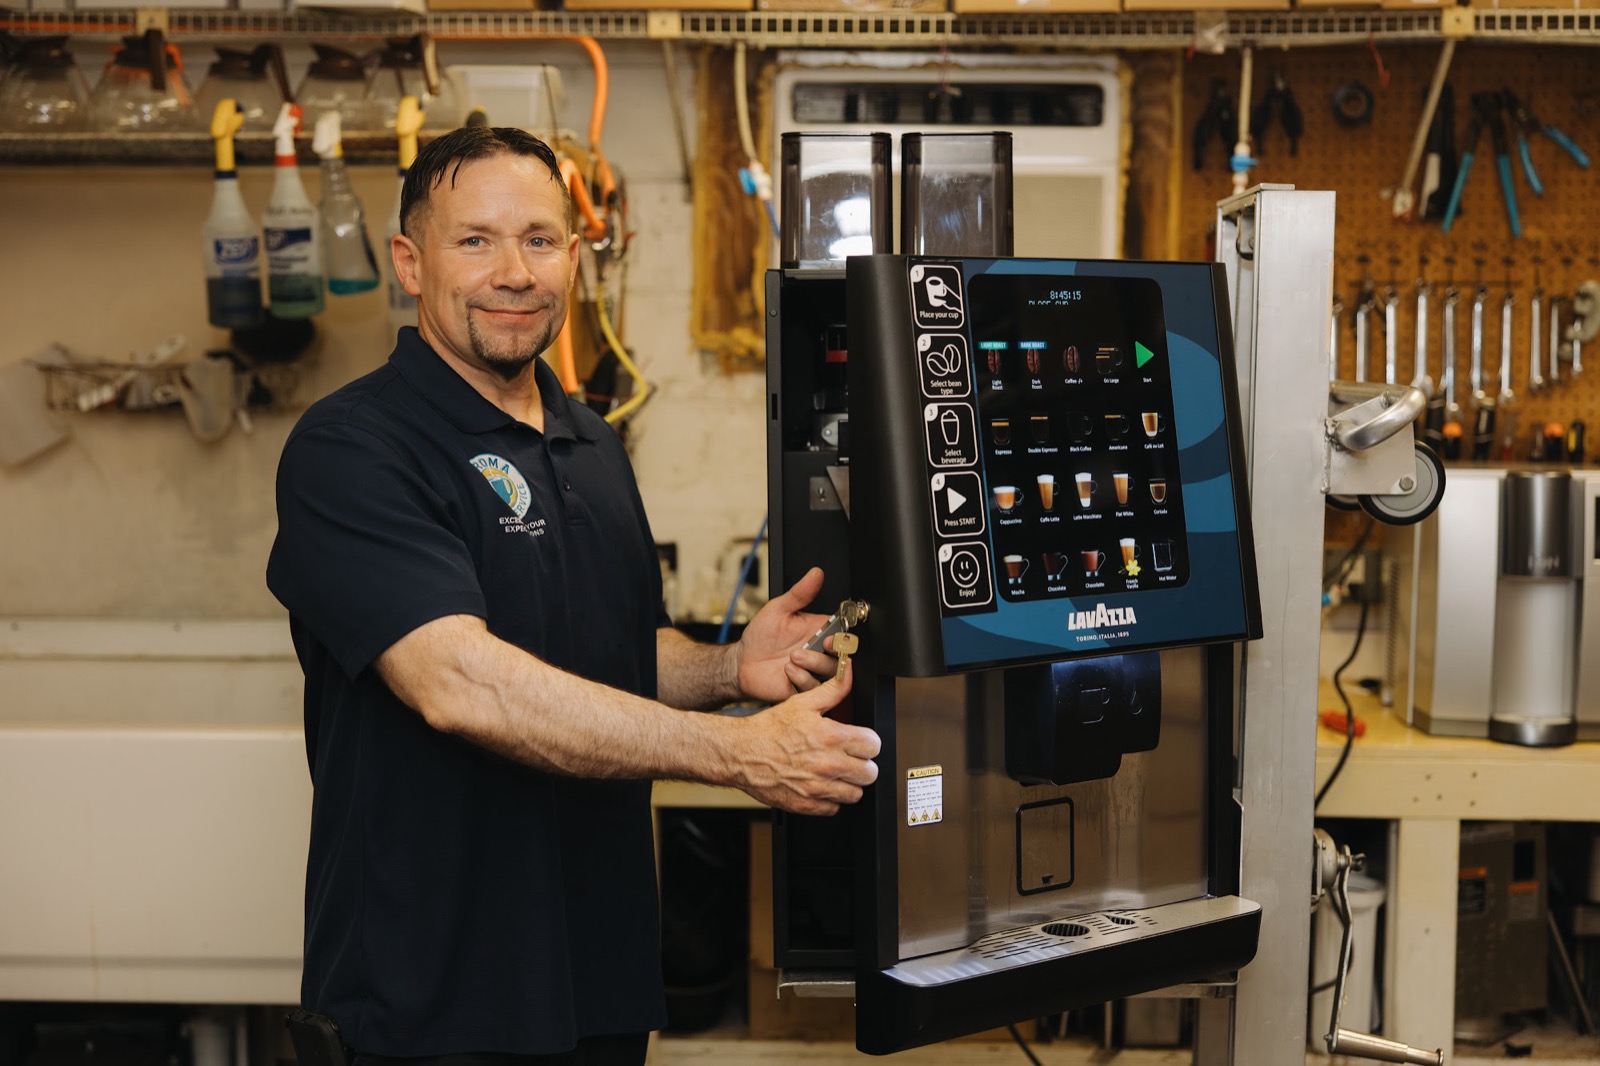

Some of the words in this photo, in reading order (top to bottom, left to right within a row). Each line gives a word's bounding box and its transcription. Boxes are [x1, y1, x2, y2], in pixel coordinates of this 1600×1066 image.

[1050, 290, 1082, 300] 8:45:15
[960, 518, 976, 526] START
[959, 589, 977, 597] Enjoy!
[1068, 603, 1137, 631] LAVAZZA
[916, 768, 940, 776] CAUTION
